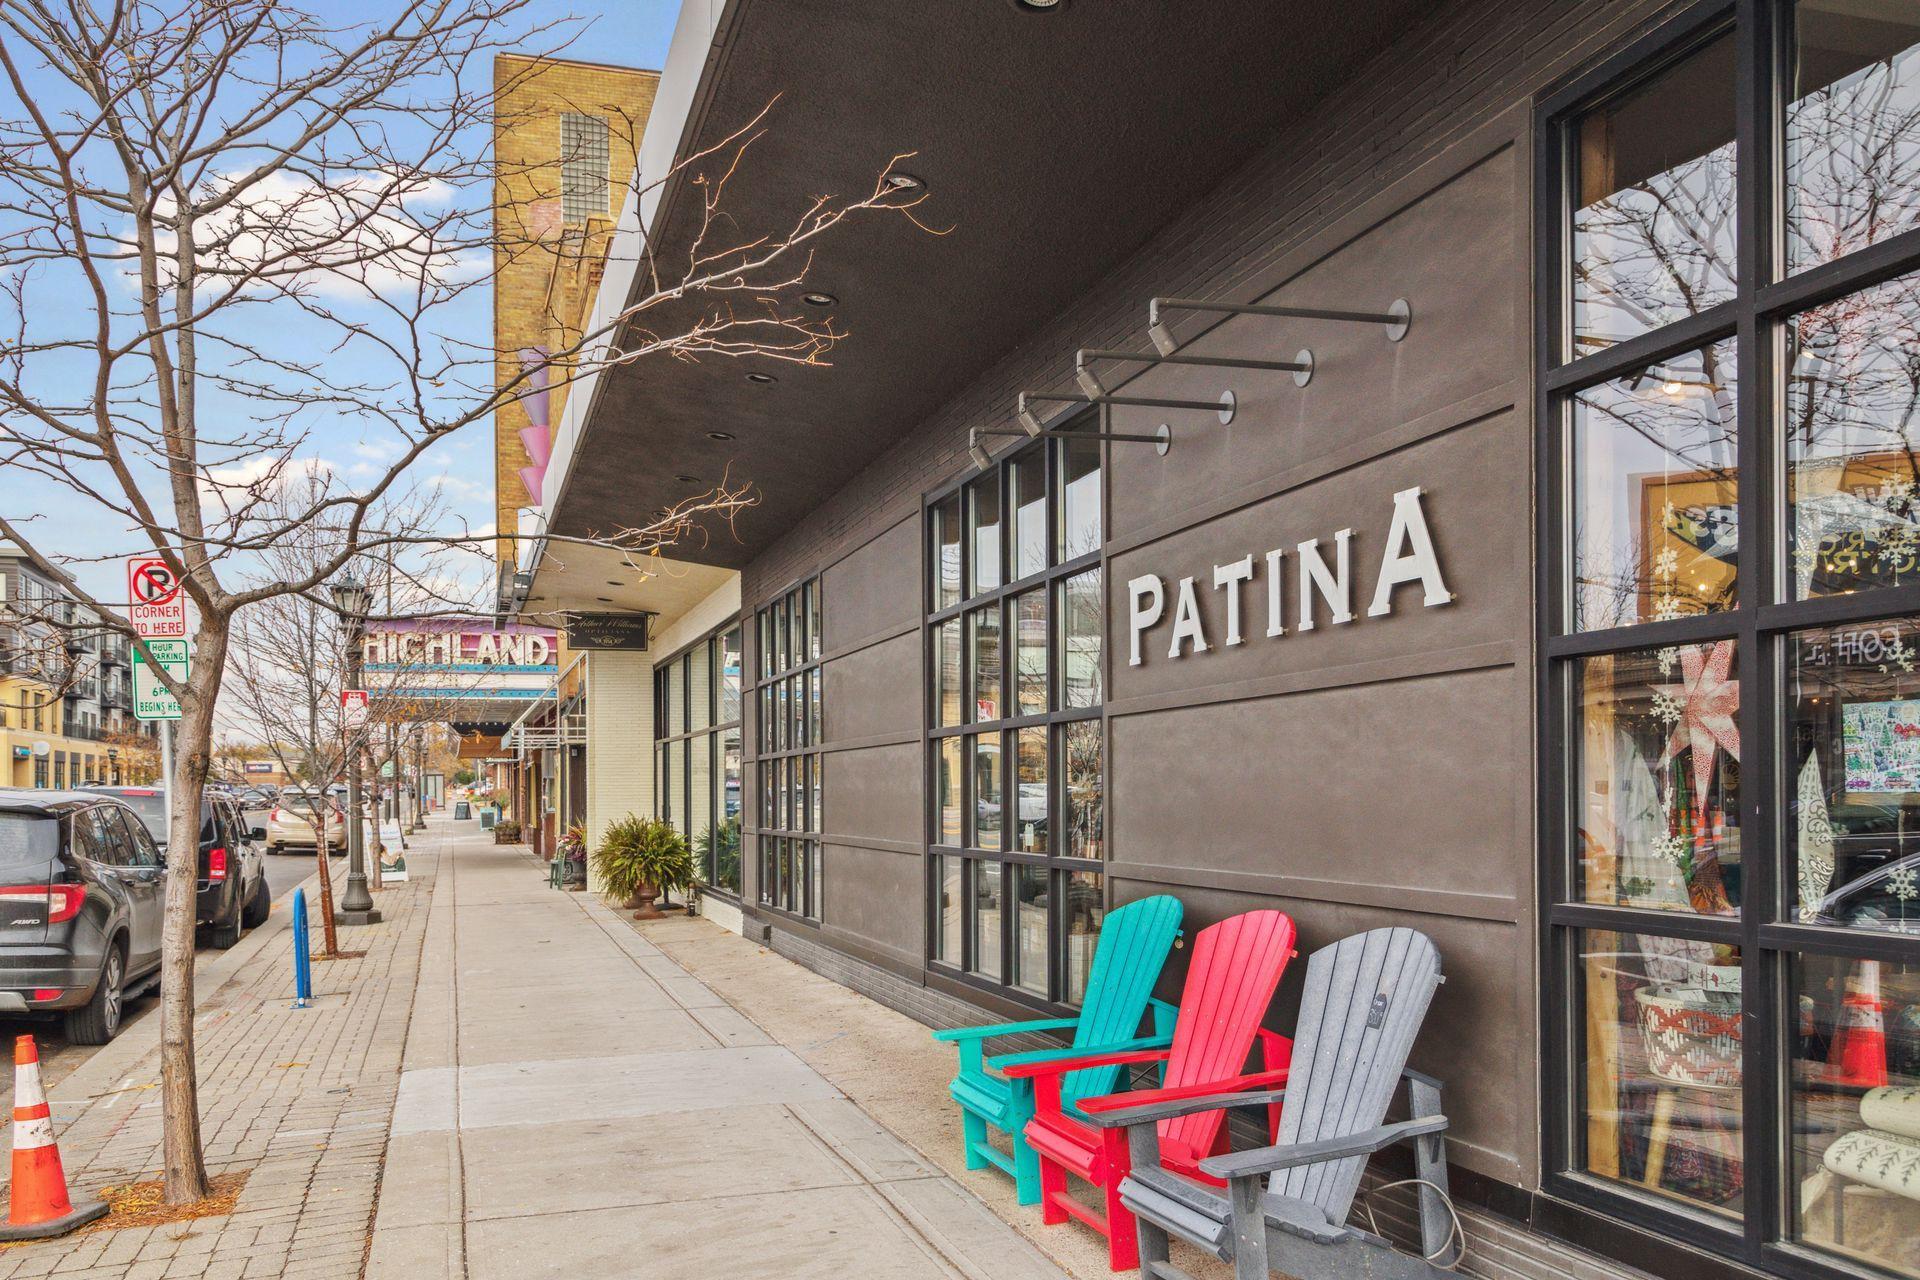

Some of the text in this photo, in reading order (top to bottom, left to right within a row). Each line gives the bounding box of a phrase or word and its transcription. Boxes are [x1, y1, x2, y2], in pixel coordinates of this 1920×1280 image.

[1128, 486, 1452, 666] PATINA
[135, 606, 180, 619] CORNER
[134, 622, 183, 634] TO HERE
[152, 643, 174, 652] HOUR
[364, 631, 549, 667] HIGHLAND
[140, 701, 165, 712] BEGINS
